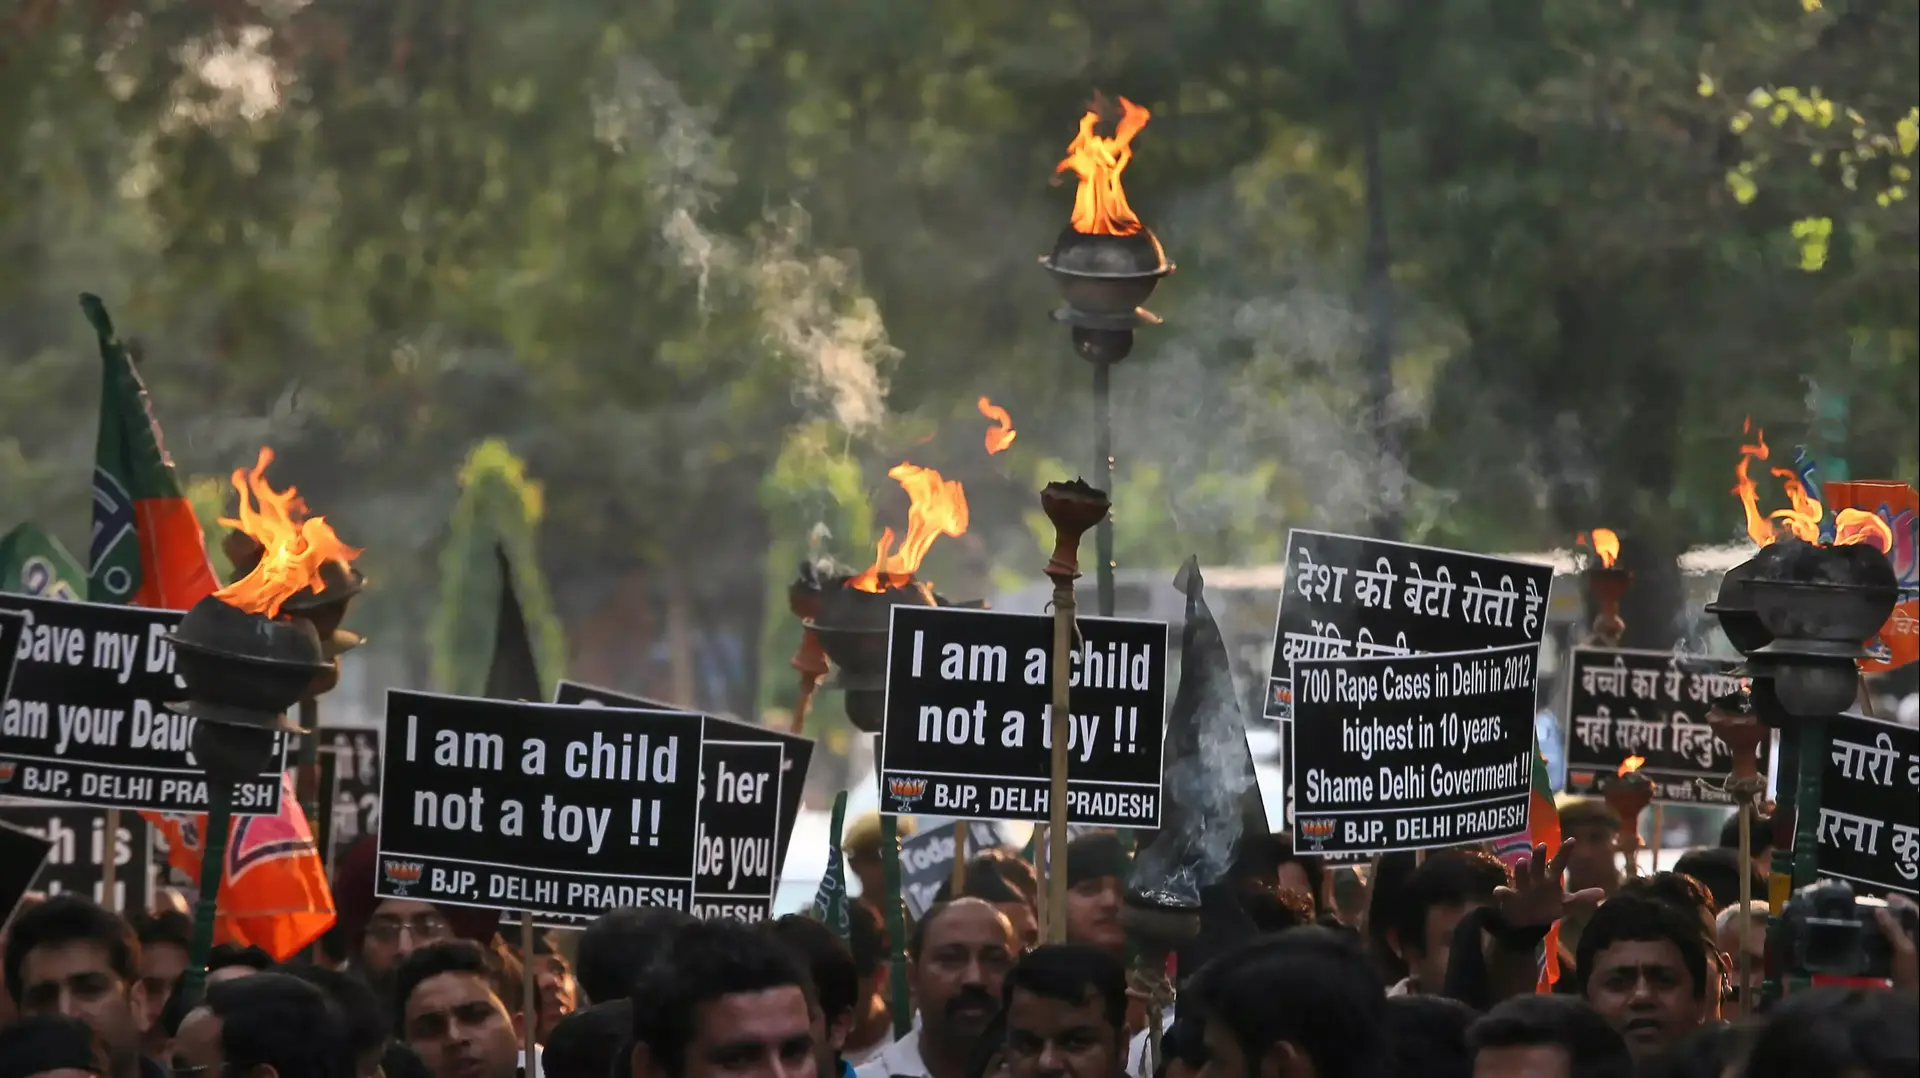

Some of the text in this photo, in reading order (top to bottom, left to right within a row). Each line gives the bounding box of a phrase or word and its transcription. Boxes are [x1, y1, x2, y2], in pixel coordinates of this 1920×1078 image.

[1297, 547, 1543, 638] देश की बेटी रोती है
[17, 609, 187, 688] Save my Di
[911, 630, 1151, 690] I am a child
[1301, 668, 1329, 703] 700
[1335, 668, 1378, 709] Rape
[1382, 666, 1430, 702] Cases
[1435, 664, 1448, 698] in
[1452, 661, 1486, 696] Delhi
[1490, 658, 1500, 692] in
[1631, 669, 1660, 699] का
[3, 698, 49, 739] am
[55, 704, 125, 755] your
[406, 716, 417, 761] I
[435, 729, 503, 770] am
[521, 739, 546, 775] a
[565, 732, 678, 783] child
[917, 700, 987, 745] not
[1001, 710, 1025, 748] a
[1113, 706, 1138, 753] !!
[1342, 718, 1413, 760] highest
[1419, 715, 1434, 748] in
[1440, 713, 1457, 747] 10
[716, 761, 769, 804] her
[1306, 751, 1529, 803] Shame Delhi Government !!
[1831, 732, 1900, 786] नारी
[23, 767, 274, 807] BJP, DELHI PRASH
[934, 784, 1154, 818] BJP, DELH PRADESH
[413, 787, 484, 832] not
[500, 802, 523, 836] a
[541, 795, 611, 855] toy
[630, 799, 661, 846] !!
[1344, 805, 1525, 846] BJP, DELHI PRADESH
[697, 823, 769, 891] be you
[431, 868, 684, 909] BJP, DELHI PRADESH
